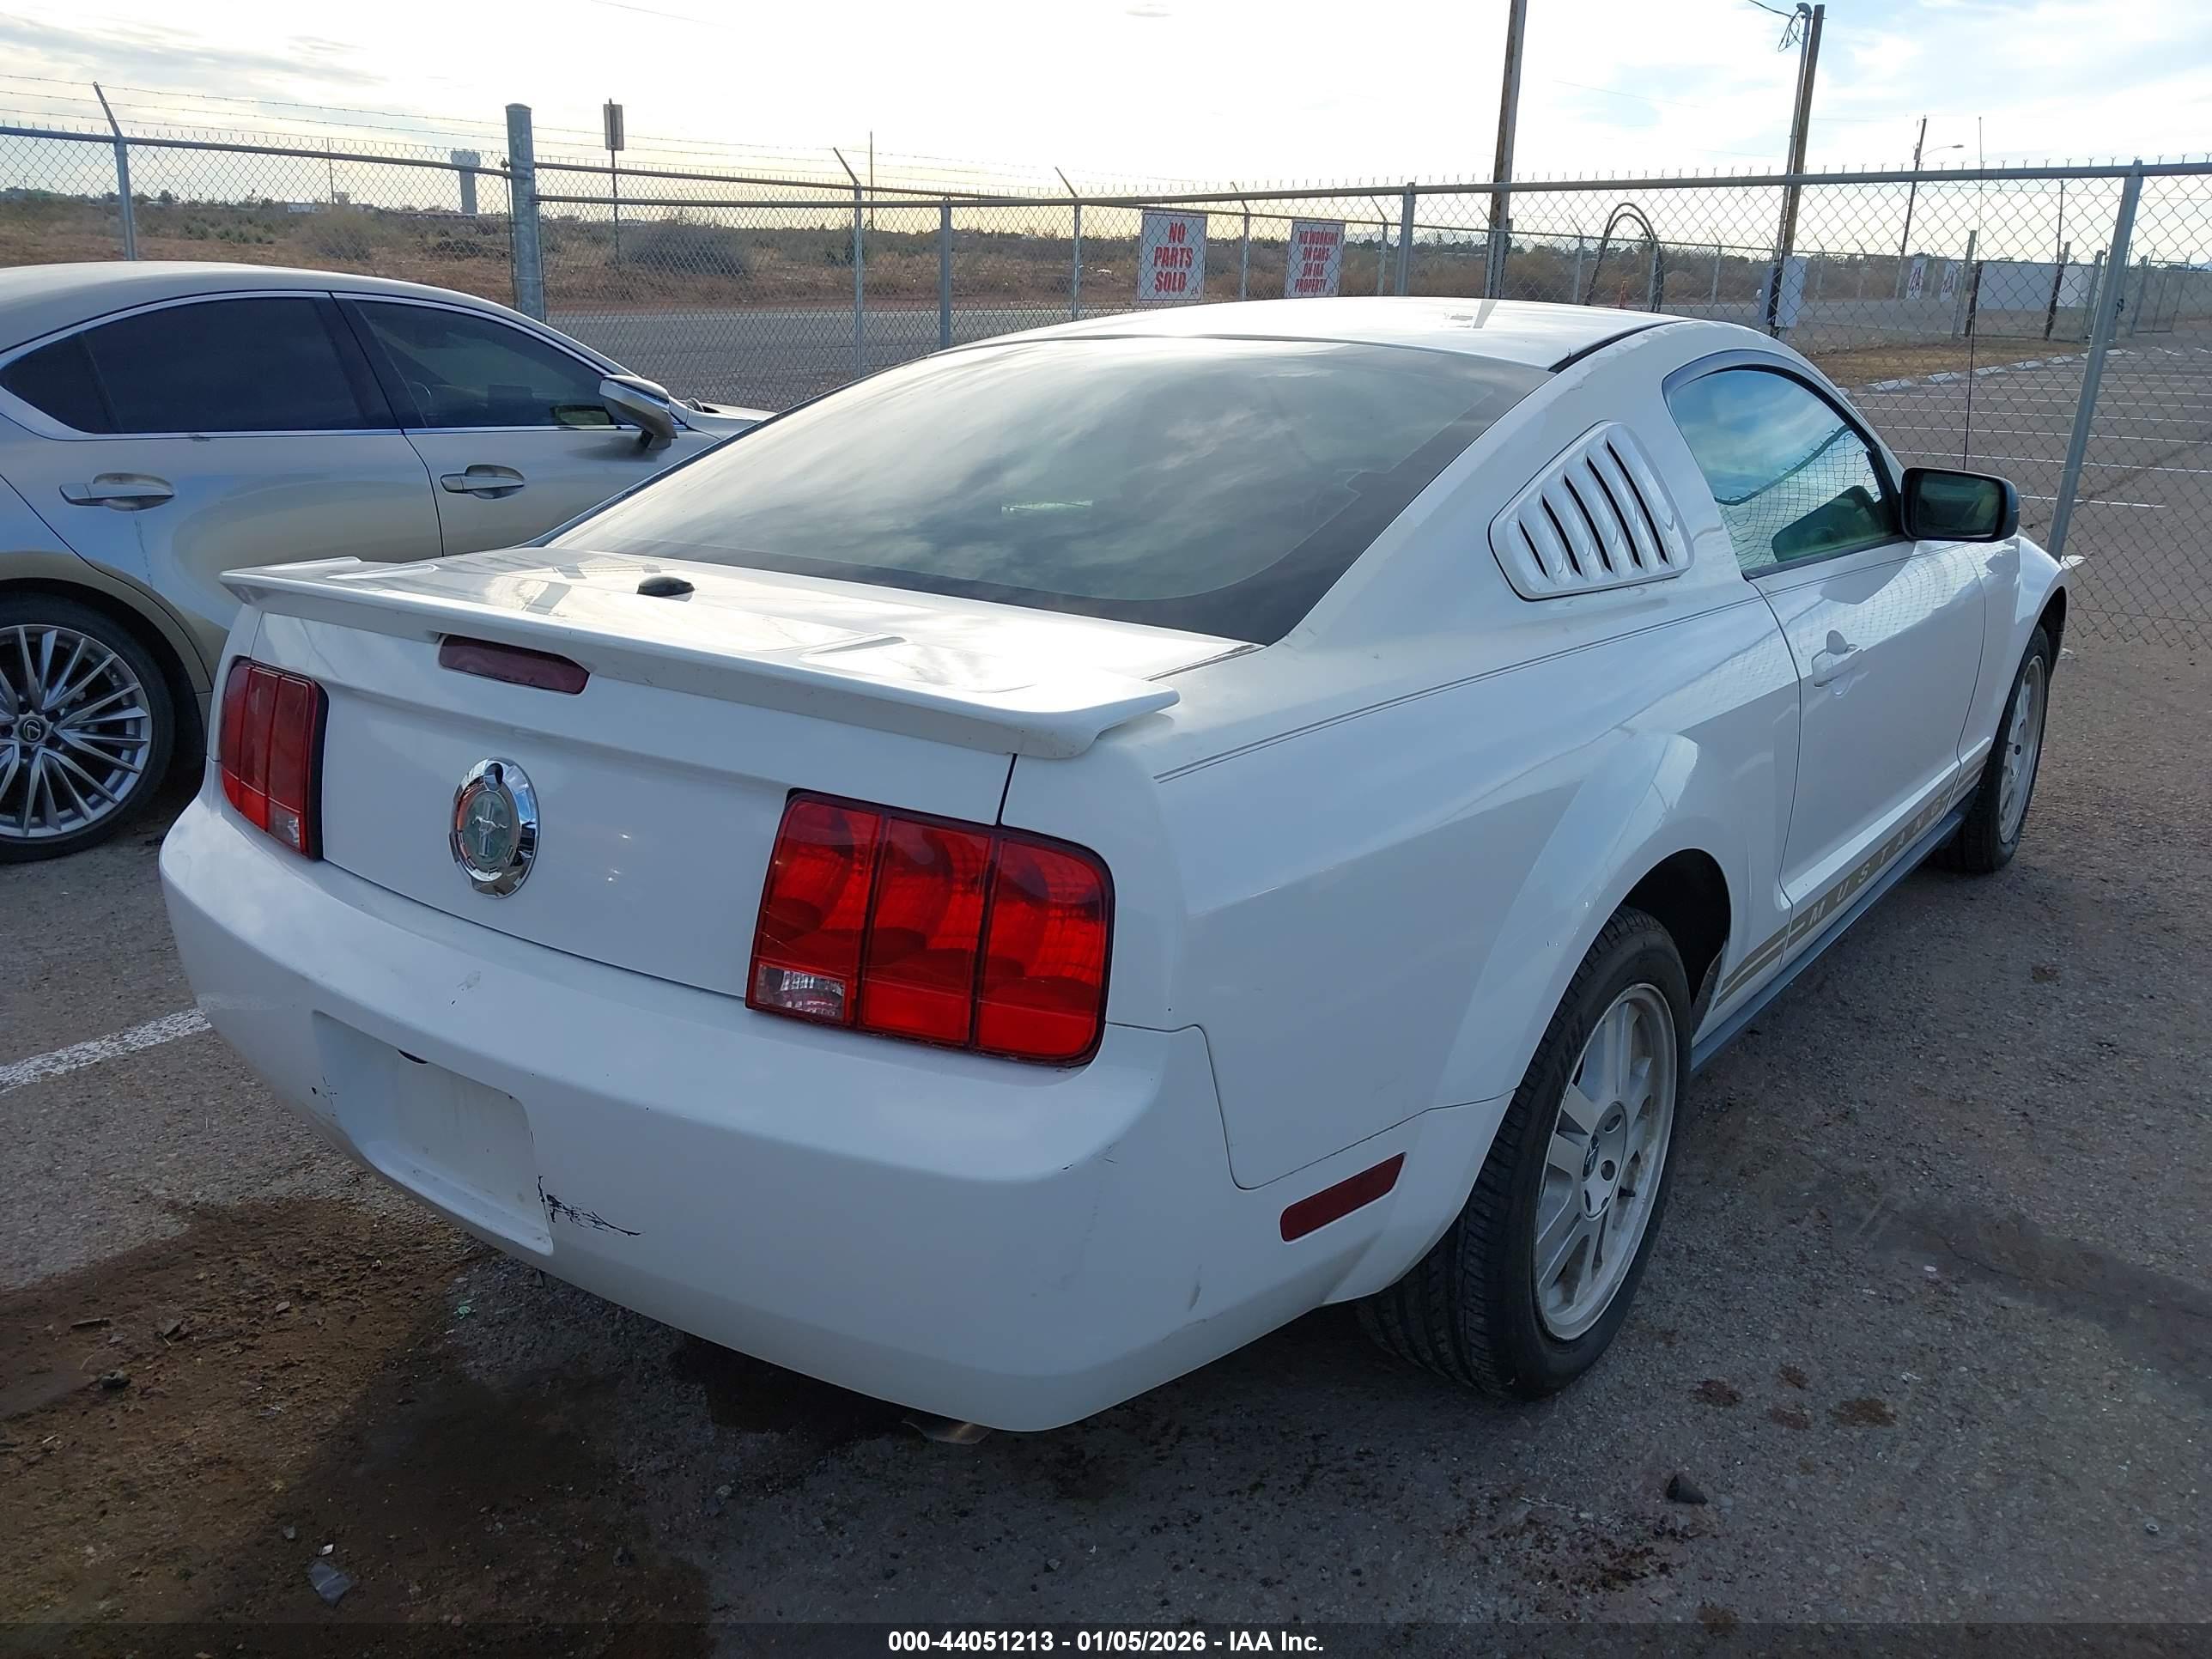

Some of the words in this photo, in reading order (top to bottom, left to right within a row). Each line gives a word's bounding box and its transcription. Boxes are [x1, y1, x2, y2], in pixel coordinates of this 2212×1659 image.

[1169, 222, 1186, 244] NO
[1298, 231, 1309, 245] NO
[1153, 246, 1193, 268] PARTS
[1303, 246, 1313, 261] ON
[1313, 246, 1330, 262] CARS
[1155, 270, 1186, 292] SOLD
[1295, 278, 1328, 292] PROPERTY
[1808, 798, 1942, 925] MUSTANG
